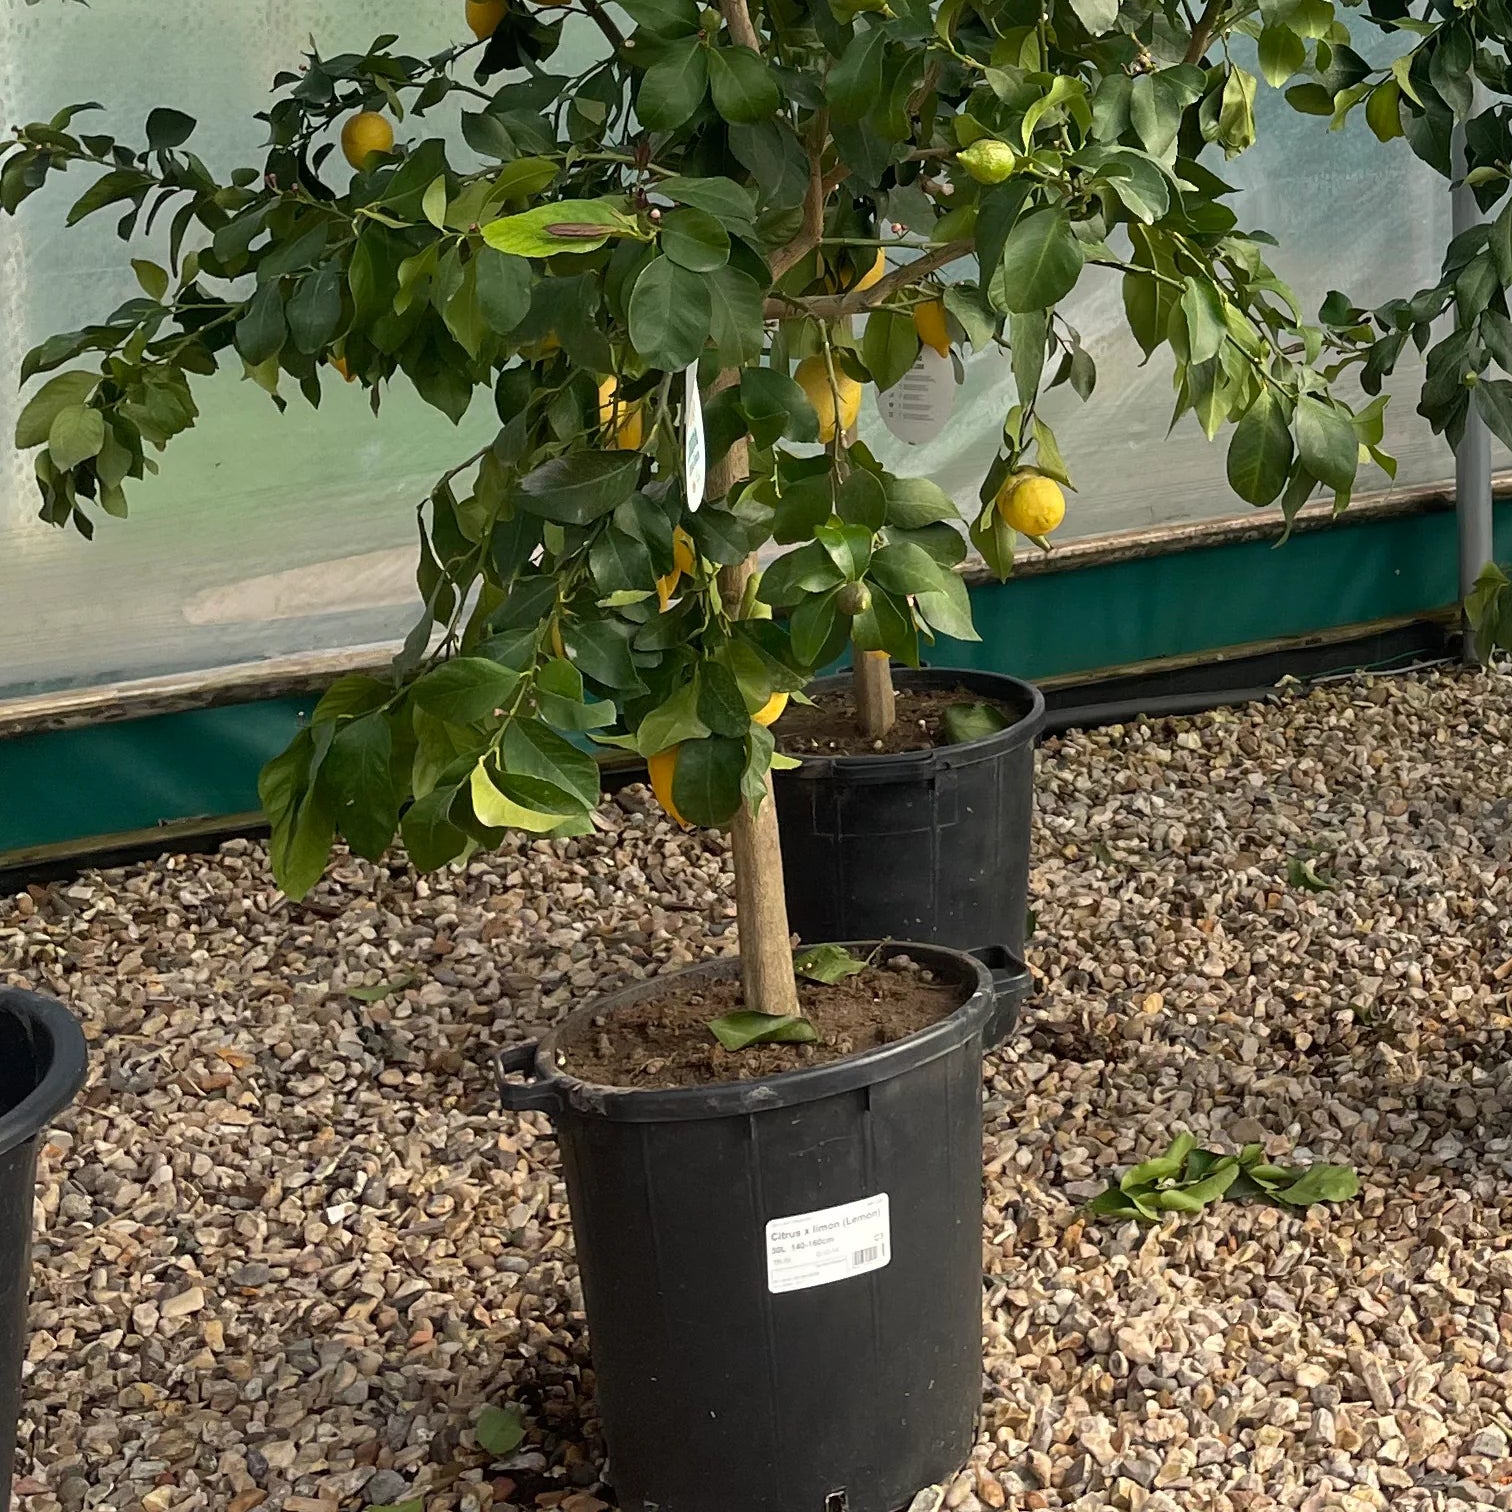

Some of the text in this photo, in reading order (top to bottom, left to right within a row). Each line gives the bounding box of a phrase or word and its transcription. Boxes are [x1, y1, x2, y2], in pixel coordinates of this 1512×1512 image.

[771, 1229, 801, 1241] Citrus
[812, 1221, 840, 1234] limon
[843, 1208, 881, 1227] (Lemon)
